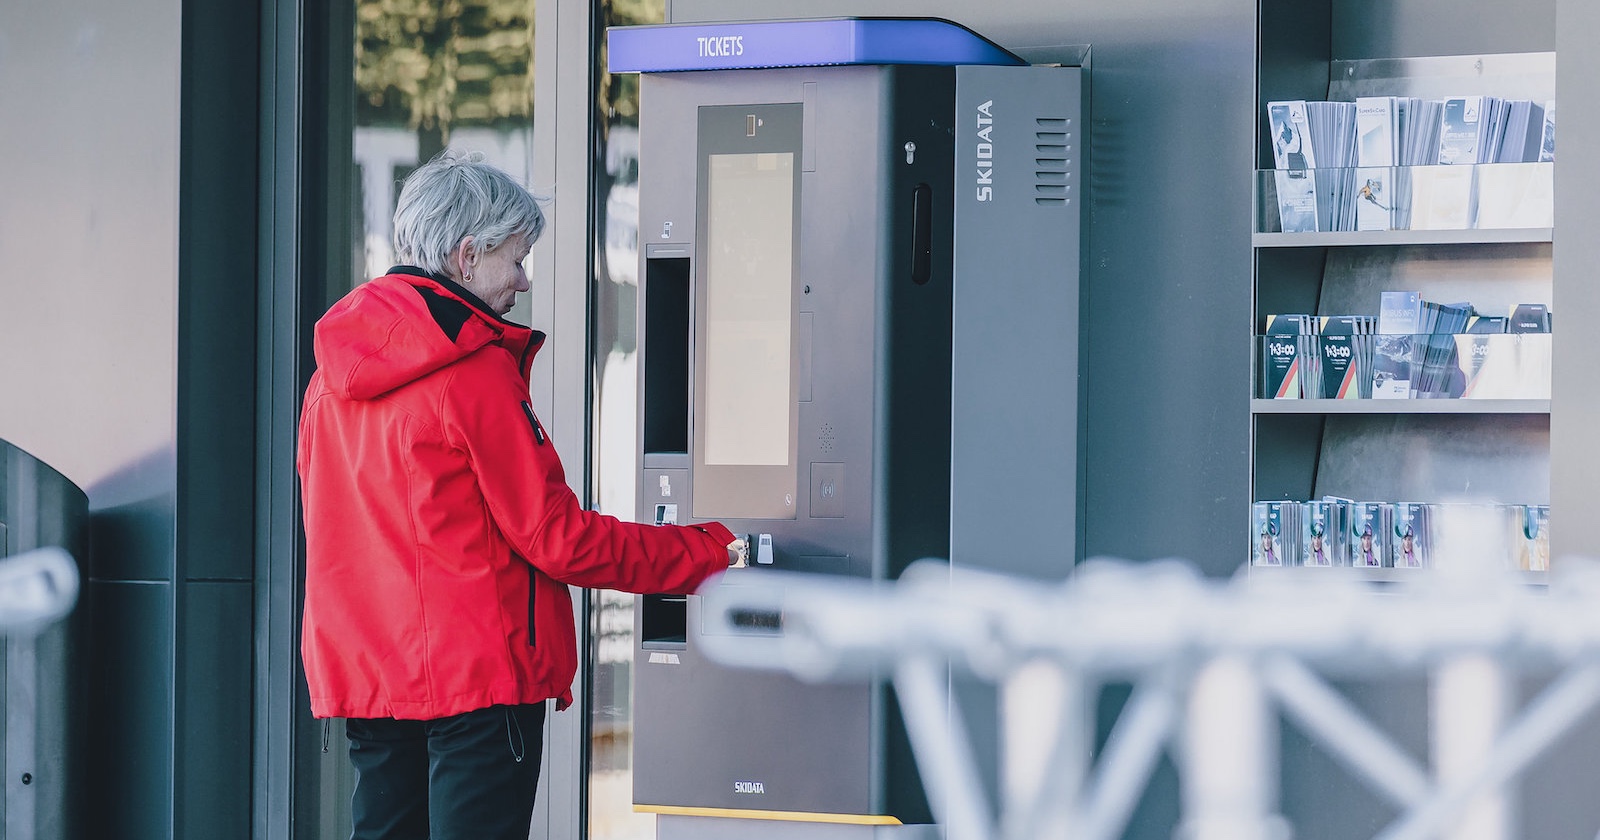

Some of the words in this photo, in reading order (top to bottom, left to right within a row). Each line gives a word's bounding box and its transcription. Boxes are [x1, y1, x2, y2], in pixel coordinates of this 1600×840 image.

[697, 36, 744, 57] TICKETS
[977, 100, 993, 202] SKIDATA
[734, 781, 765, 794] SKIDATA
